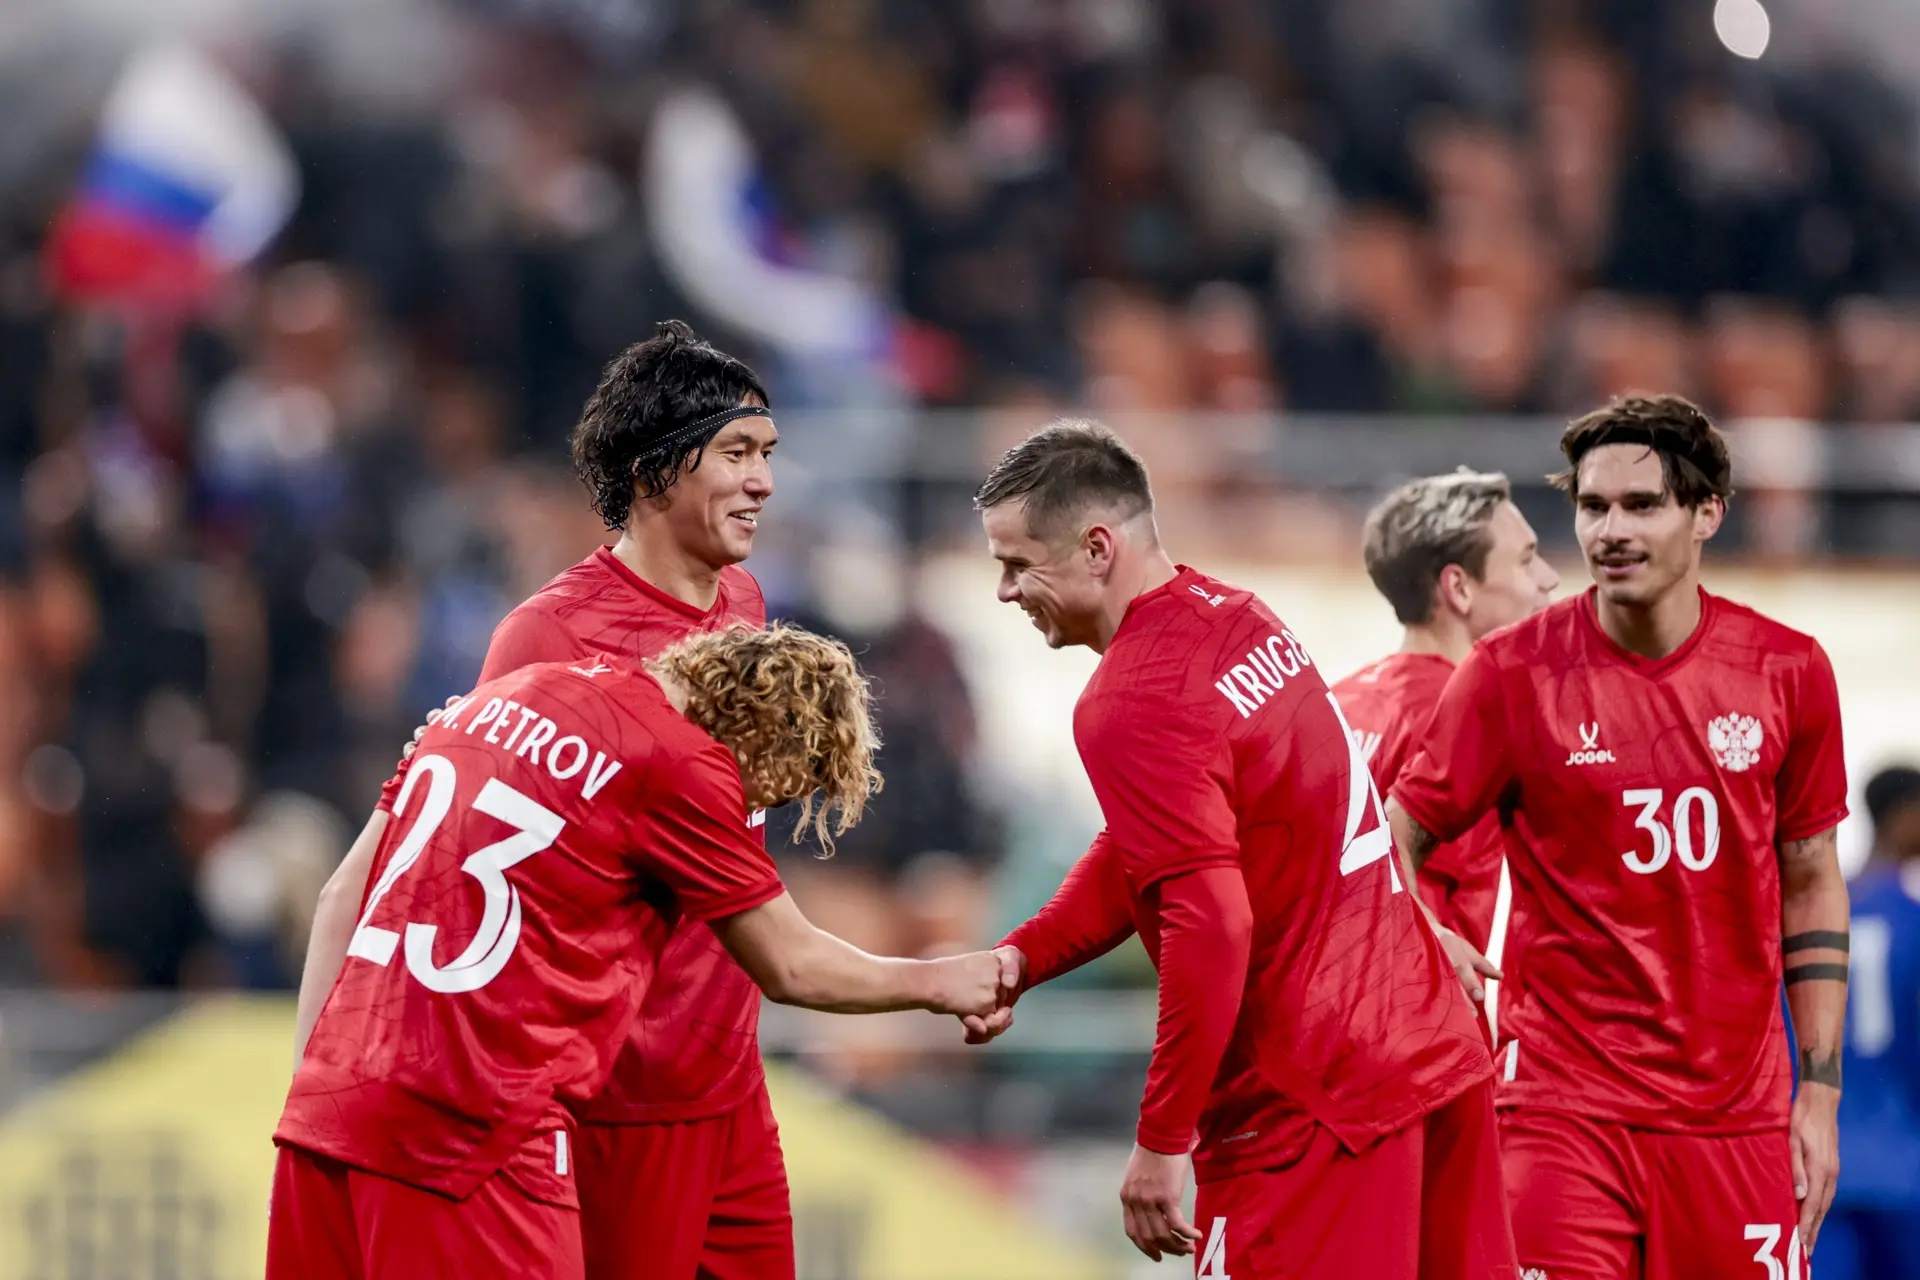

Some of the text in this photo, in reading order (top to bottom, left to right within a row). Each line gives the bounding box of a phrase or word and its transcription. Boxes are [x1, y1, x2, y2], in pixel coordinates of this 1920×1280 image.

[464, 697, 623, 801] PETROV
[1325, 690, 1404, 894] 4
[346, 753, 567, 993] 23
[1621, 786, 1721, 874] 30
[1197, 1216, 1231, 1280] 4
